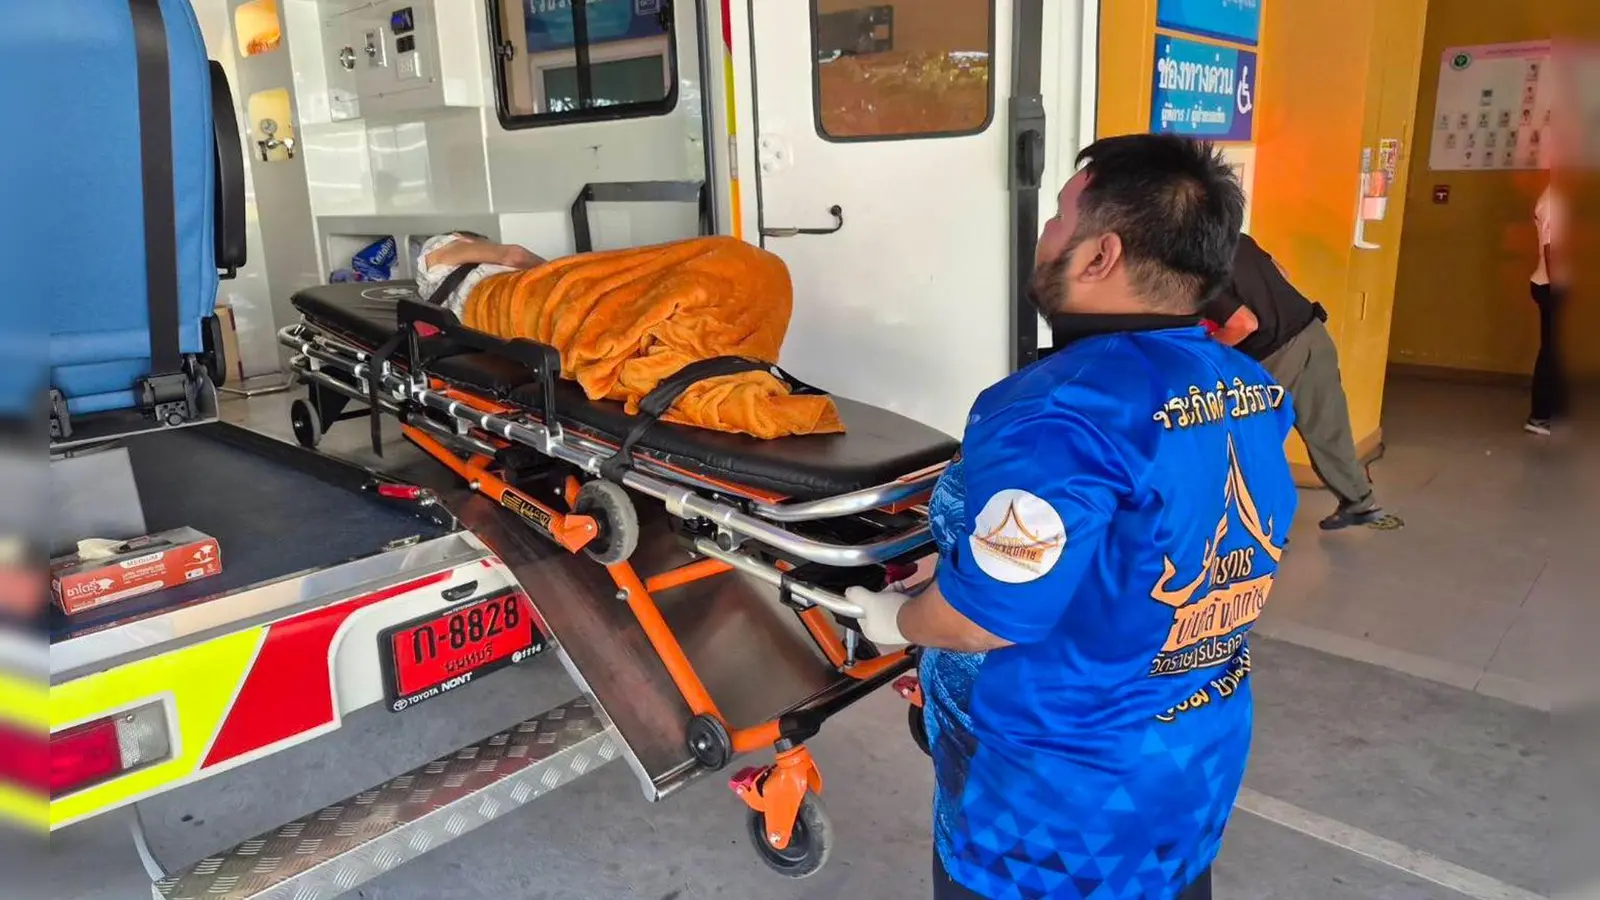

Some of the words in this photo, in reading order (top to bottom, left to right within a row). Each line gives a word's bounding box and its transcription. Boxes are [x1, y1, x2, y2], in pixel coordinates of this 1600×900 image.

[1157, 44, 1234, 96] ช่องทางด่วน
[408, 688, 439, 705] TOYOTA
[441, 672, 473, 692] NONT
